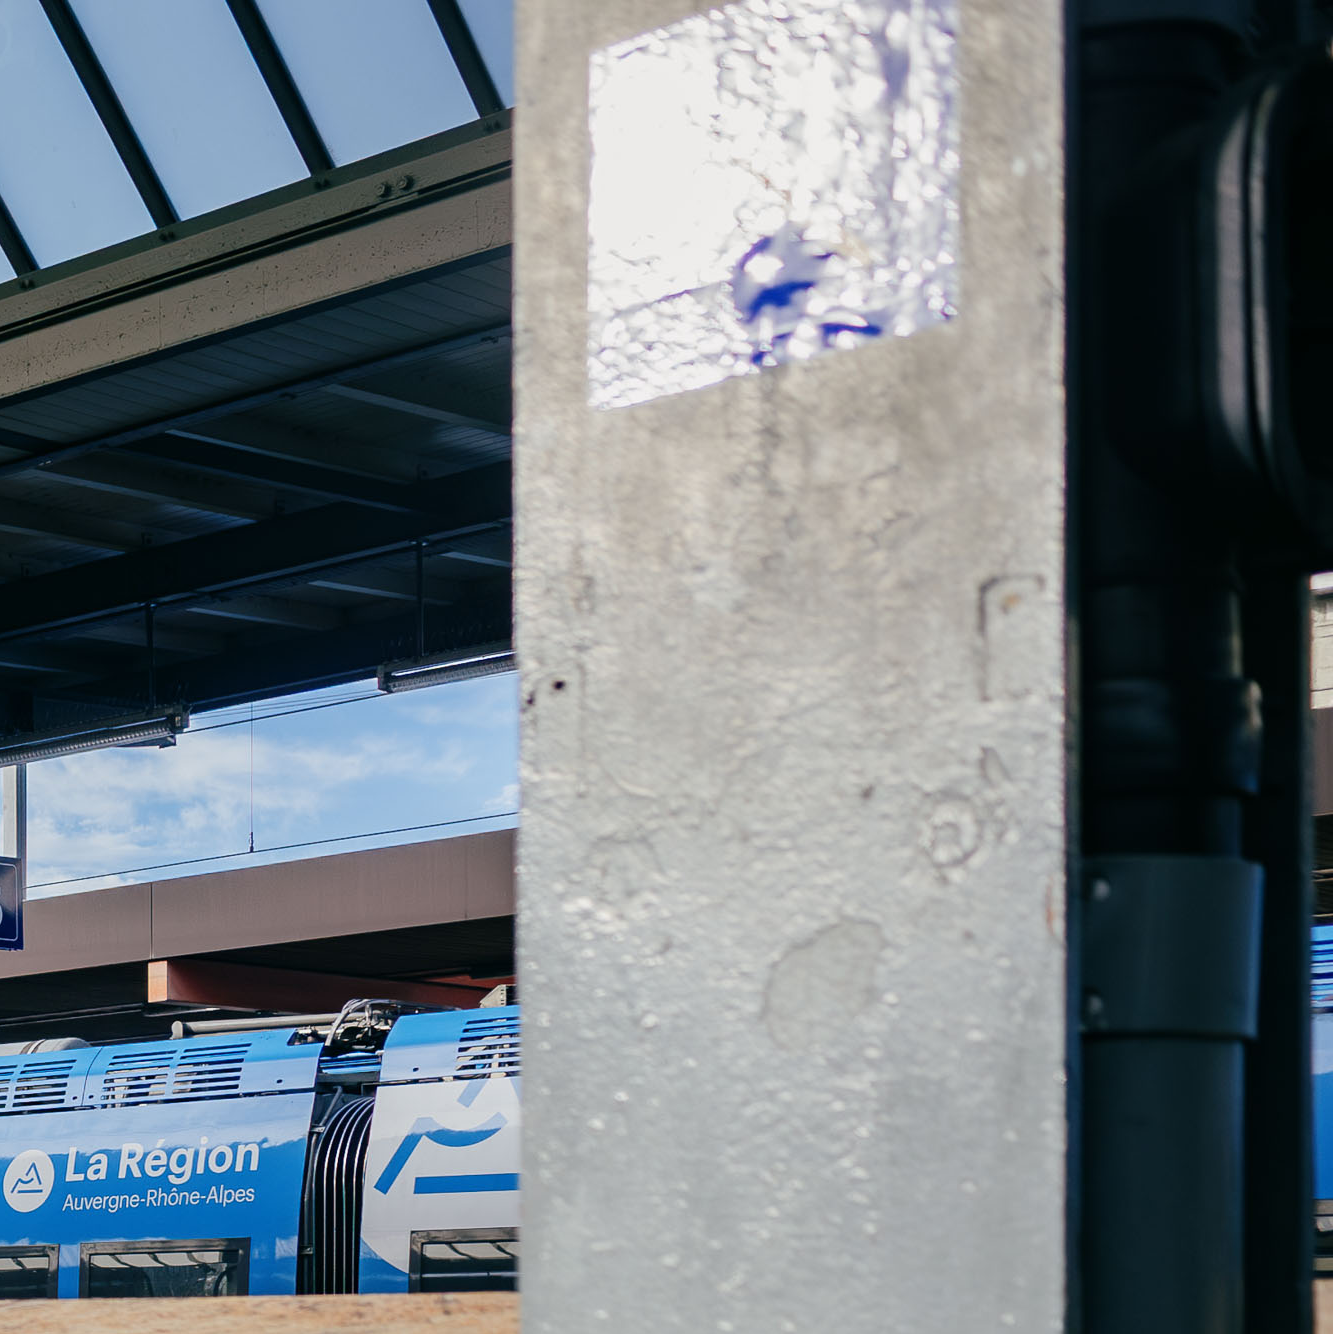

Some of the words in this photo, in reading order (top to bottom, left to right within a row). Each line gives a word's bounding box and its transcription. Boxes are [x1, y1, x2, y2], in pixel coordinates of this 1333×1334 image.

[65, 1146, 108, 1182] La
[117, 1136, 261, 1185] Région
[62, 1184, 255, 1213] Auvergne-Rhône-Alpes
